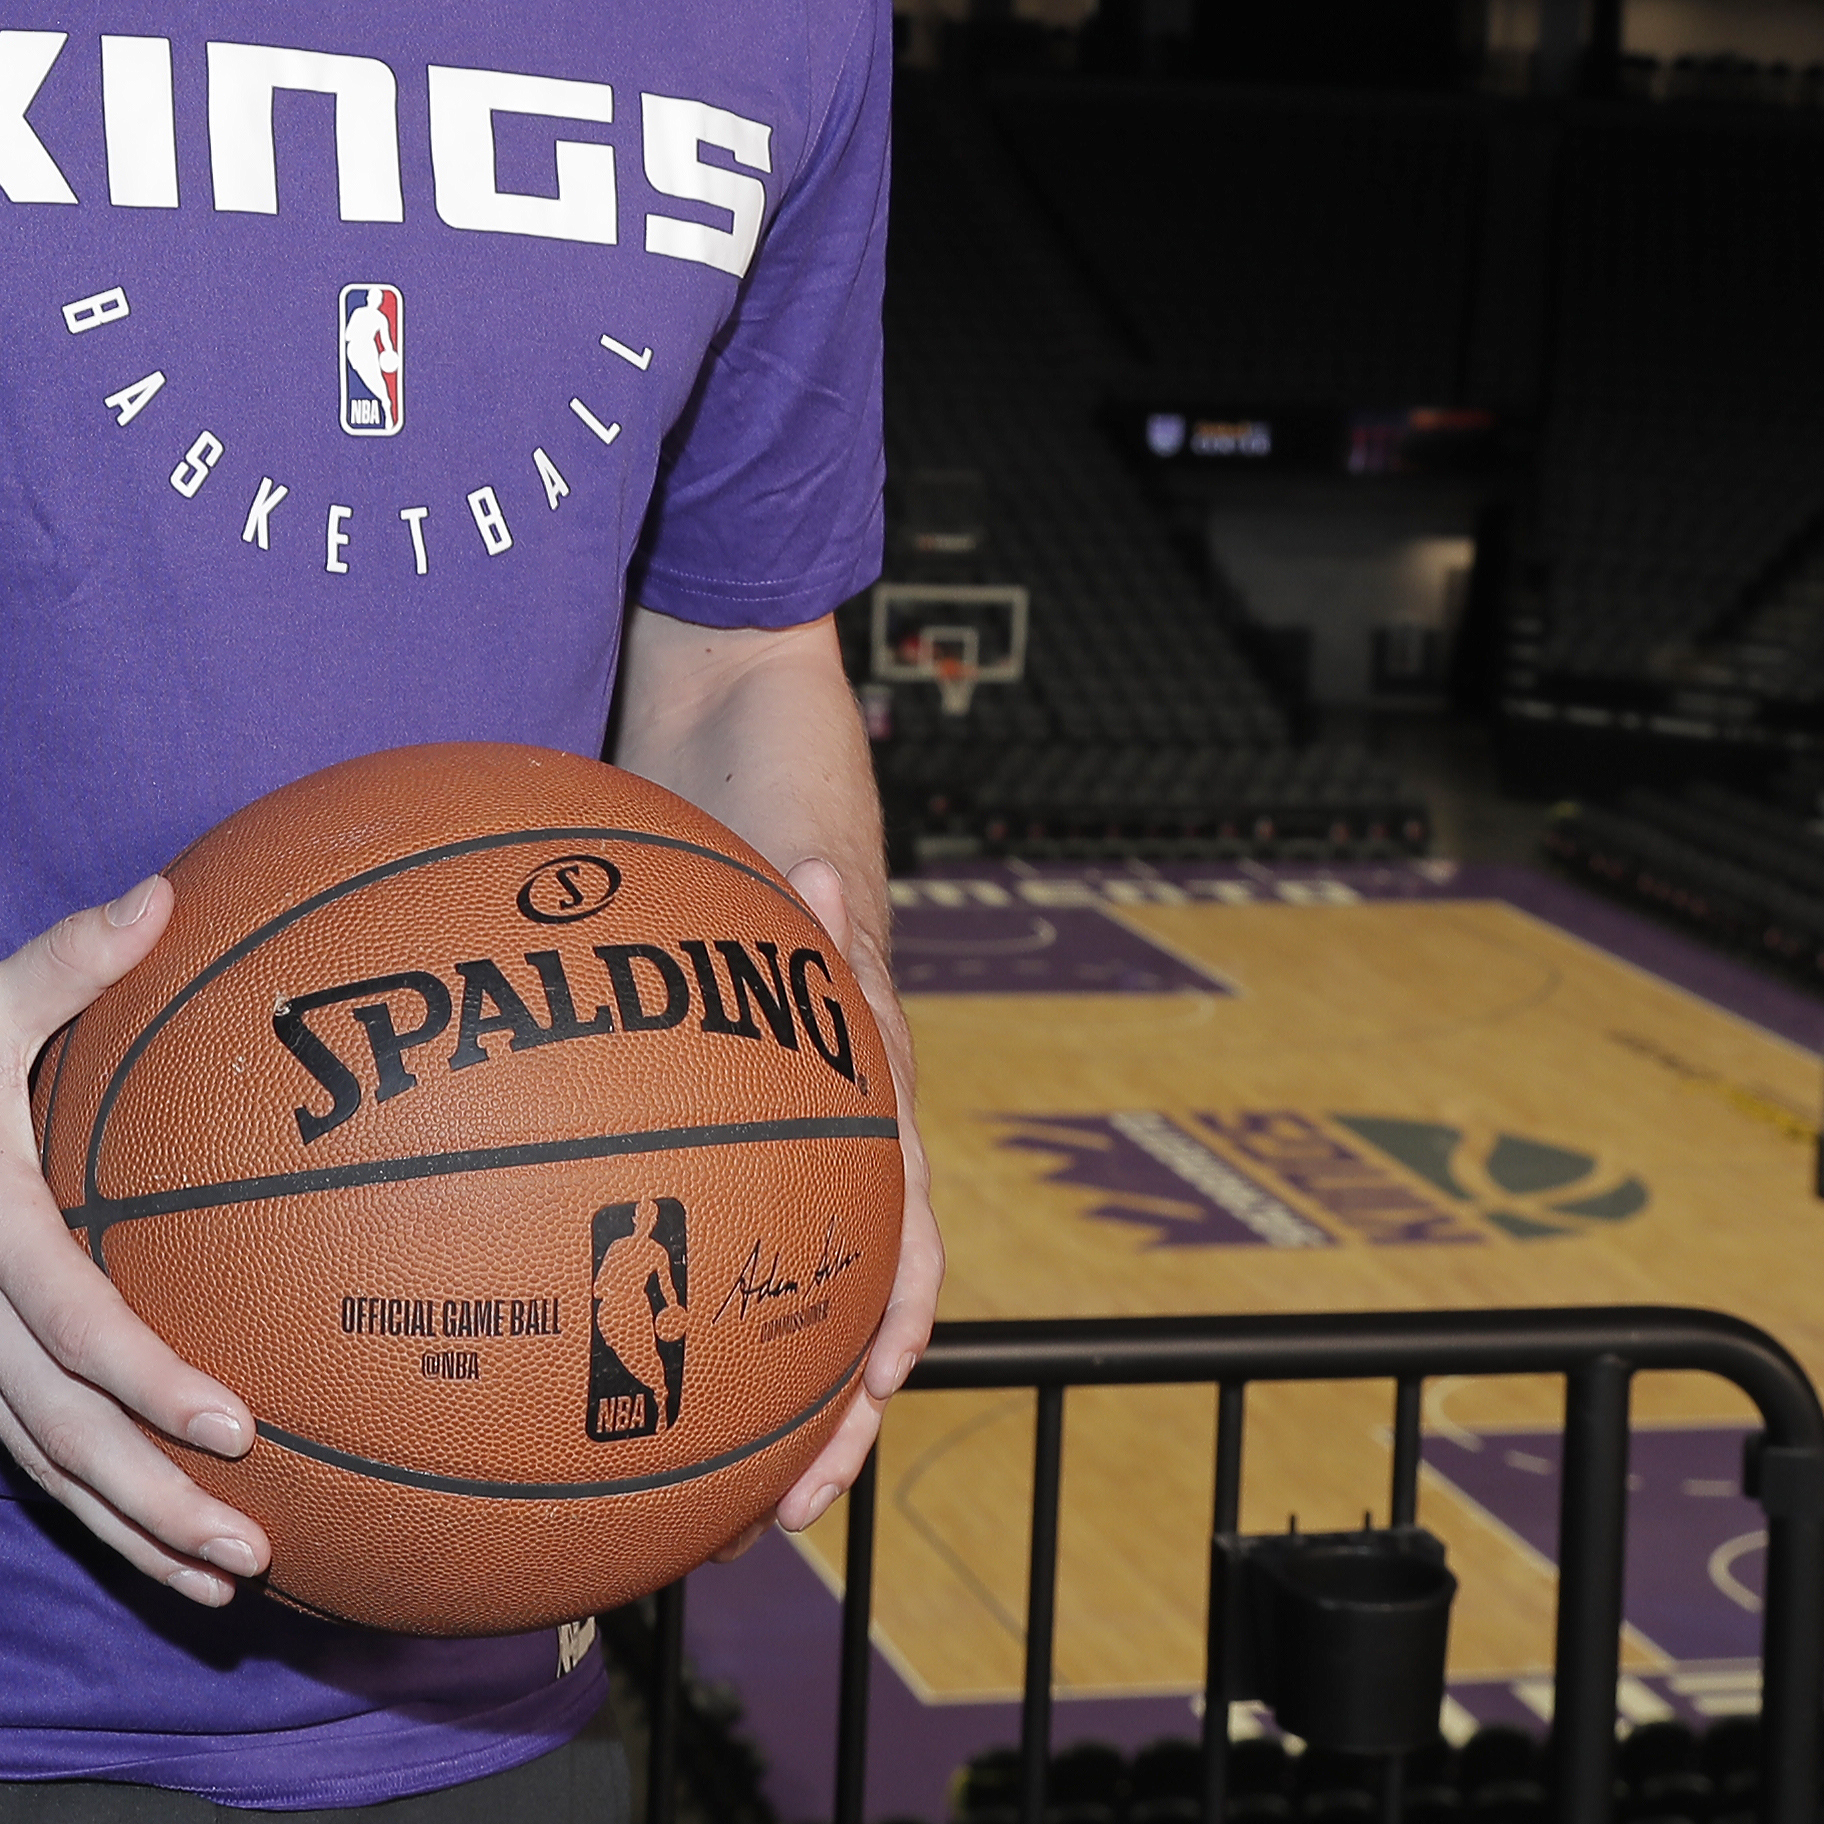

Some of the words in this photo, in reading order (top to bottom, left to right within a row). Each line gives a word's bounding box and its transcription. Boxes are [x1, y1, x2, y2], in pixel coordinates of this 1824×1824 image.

[61, 285, 654, 575] BASKETBALL
[350, 398, 381, 425] NBA
[271, 939, 857, 1146] SPALDING
[341, 1295, 437, 1338] OFFICIAL
[441, 1298, 506, 1338] GAME
[509, 1296, 563, 1336] BALL
[421, 1350, 481, 1381] @NBA
[594, 1392, 646, 1435] NBA
